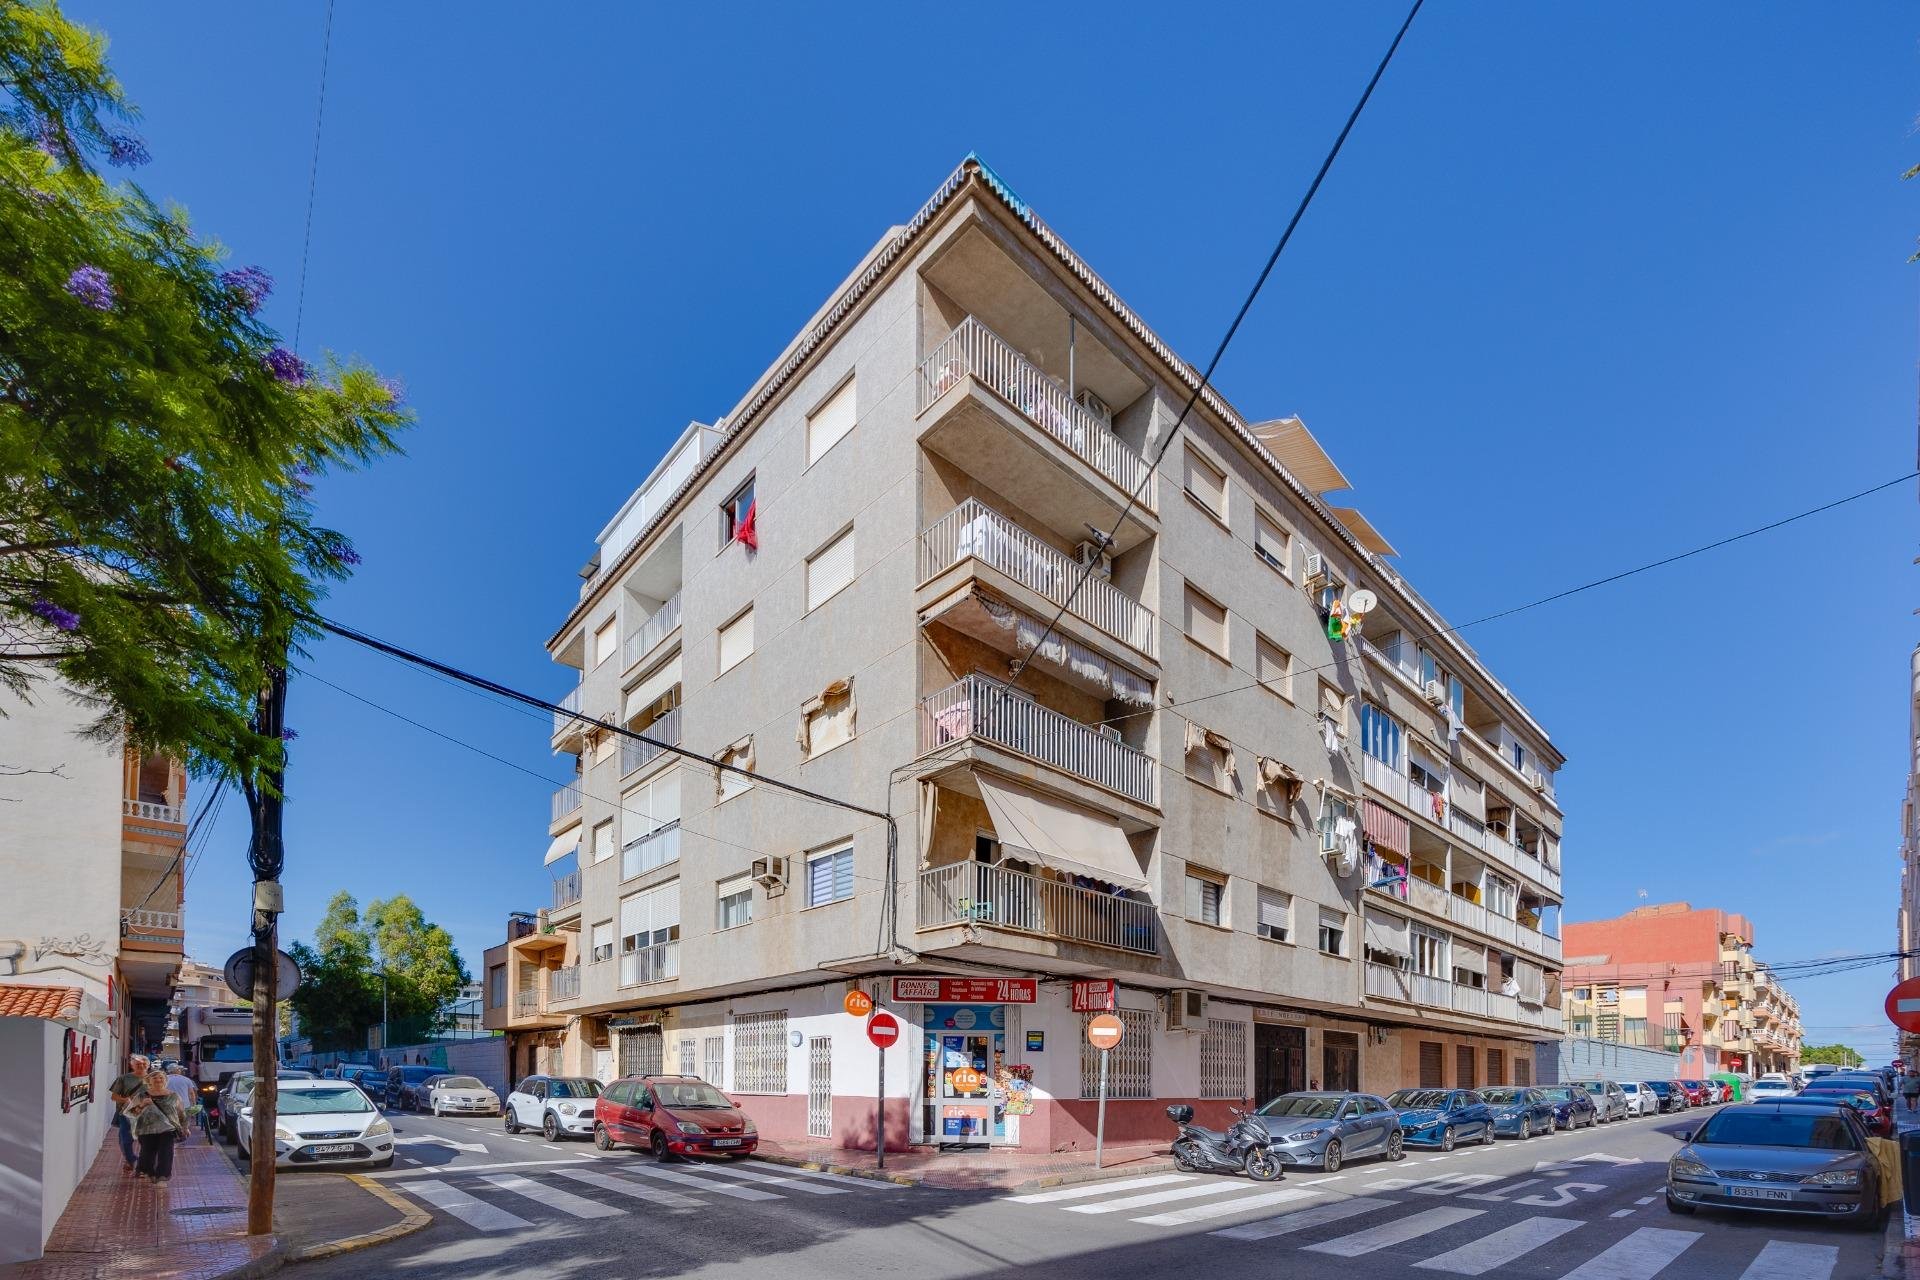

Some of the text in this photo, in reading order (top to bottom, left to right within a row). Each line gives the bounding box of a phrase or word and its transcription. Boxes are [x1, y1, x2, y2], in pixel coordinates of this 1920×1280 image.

[900, 981, 928, 989] BONNE
[997, 980, 1009, 1001] 24
[902, 988, 937, 996] AFFAIRE
[1010, 988, 1031, 1001] HORAS
[1074, 983, 1087, 1010] 24
[849, 993, 869, 1008] ria
[1088, 992, 1111, 1010] HORAS
[955, 1069, 977, 1083] ria
[948, 1106, 965, 1117] ria
[1734, 1187, 1788, 1200] 8331 FNN
